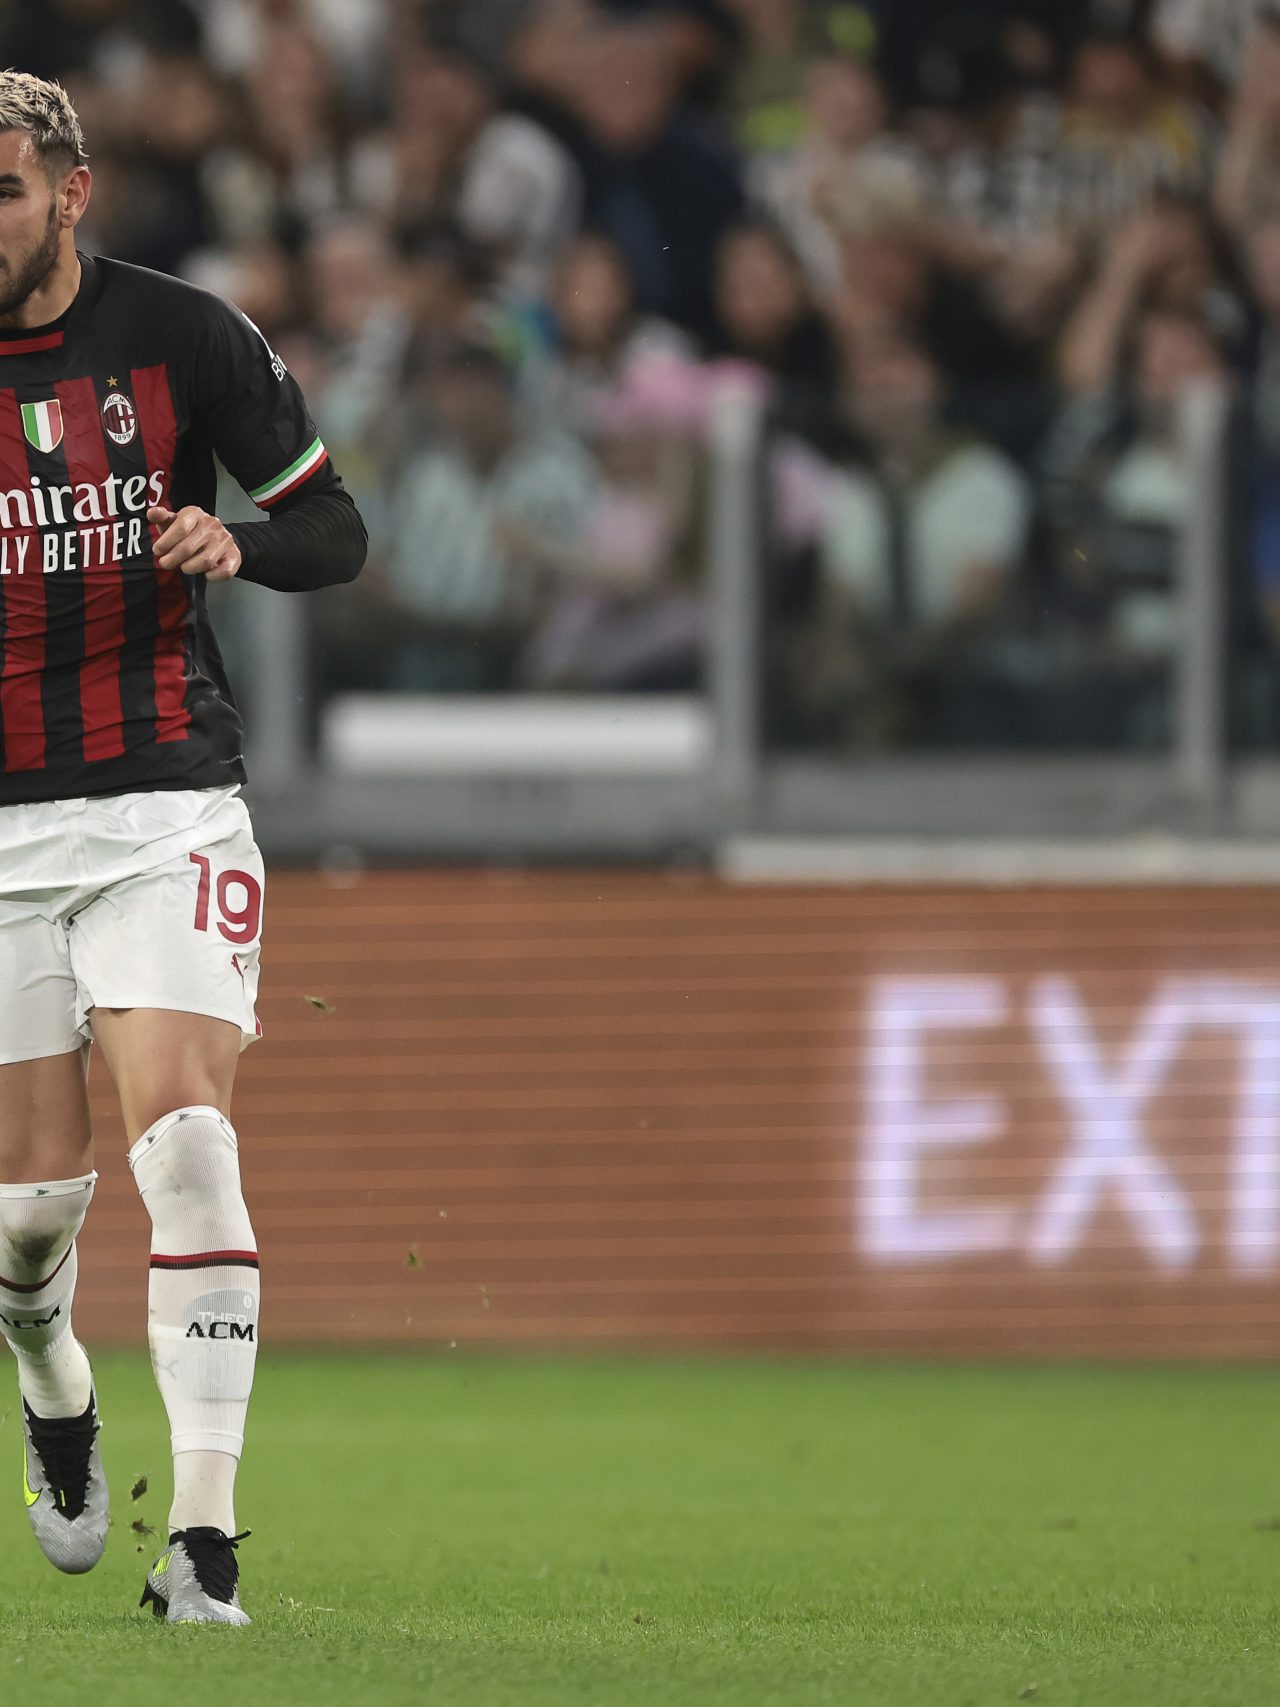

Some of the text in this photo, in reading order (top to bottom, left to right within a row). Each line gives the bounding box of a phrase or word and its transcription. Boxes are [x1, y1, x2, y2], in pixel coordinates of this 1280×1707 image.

[114, 432, 131, 441] 1899
[42, 517, 142, 574] BETTER
[189, 852, 261, 944] 19
[186, 1321, 254, 1342] ACM
